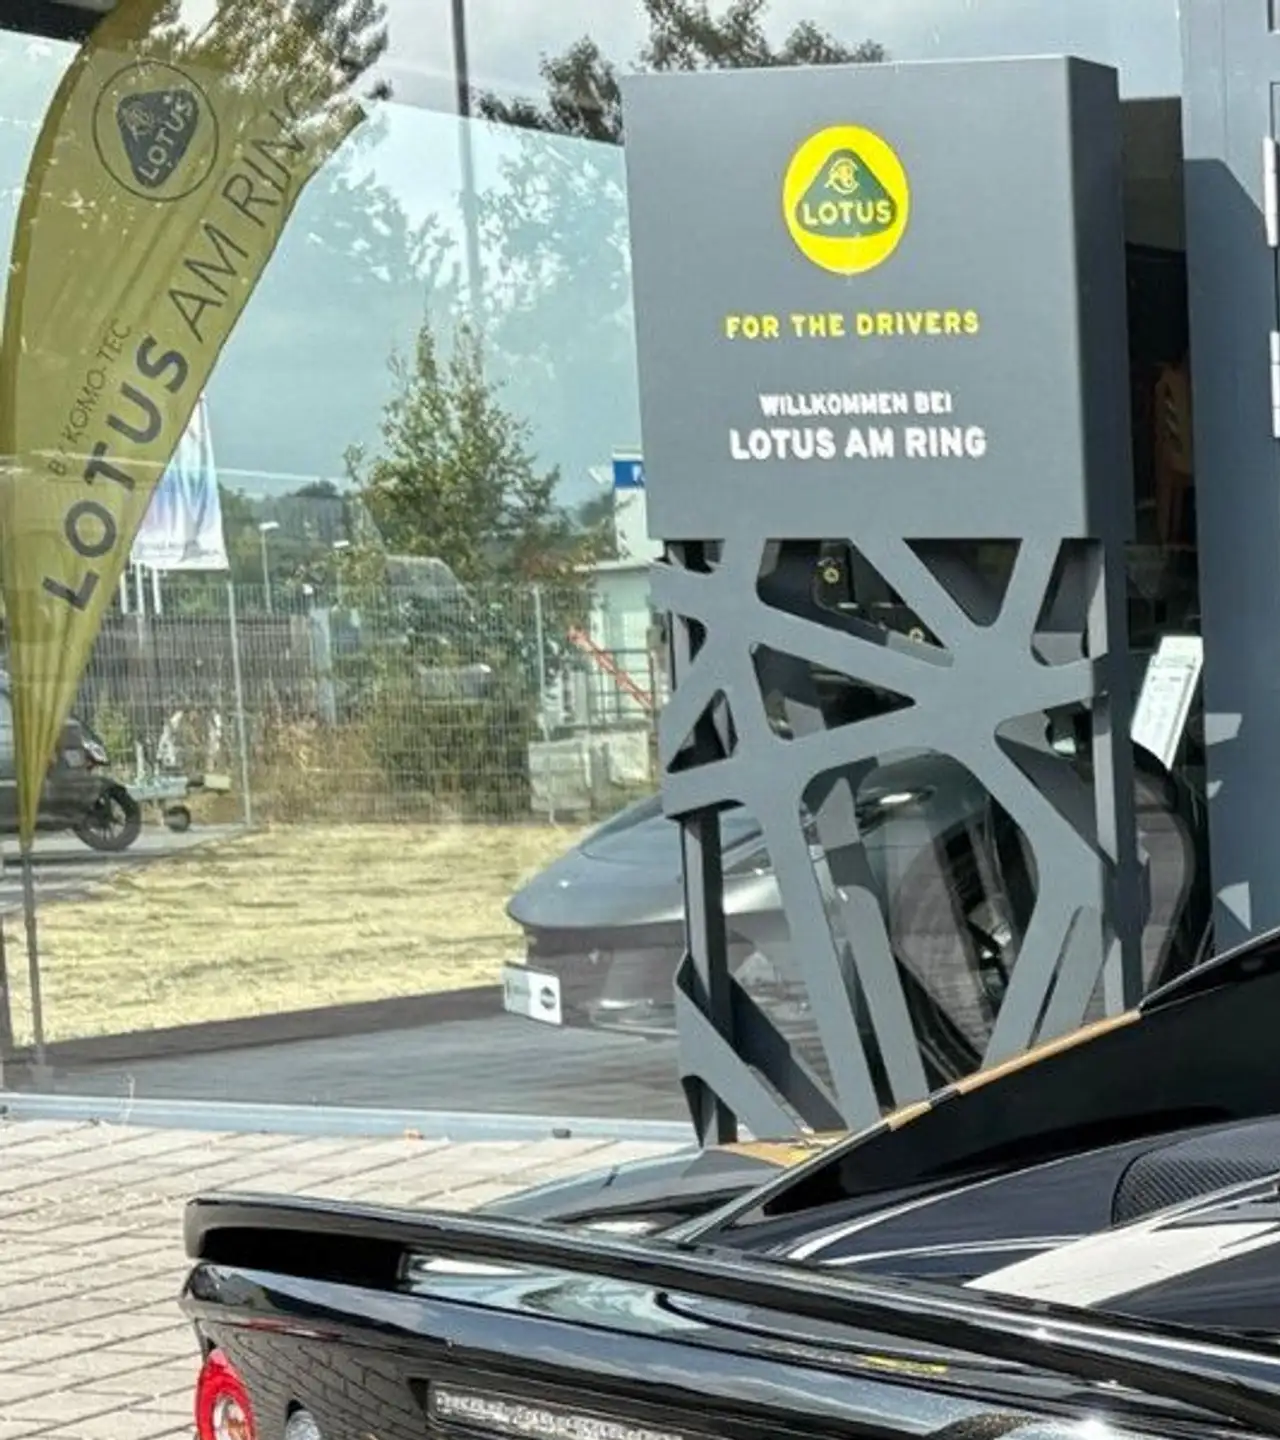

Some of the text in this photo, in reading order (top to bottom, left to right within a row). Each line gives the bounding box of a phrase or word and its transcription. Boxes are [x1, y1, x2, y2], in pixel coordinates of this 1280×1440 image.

[138, 97, 194, 180] LOTUS
[802, 200, 893, 226] LOTUS
[726, 309, 981, 339] FOR THE DRIVERS
[42, 333, 190, 612] LOTUS
[168, 221, 249, 344] AM
[759, 390, 953, 417] WILLKOMMEN BEI
[729, 425, 987, 460] LOTUS AM RING
